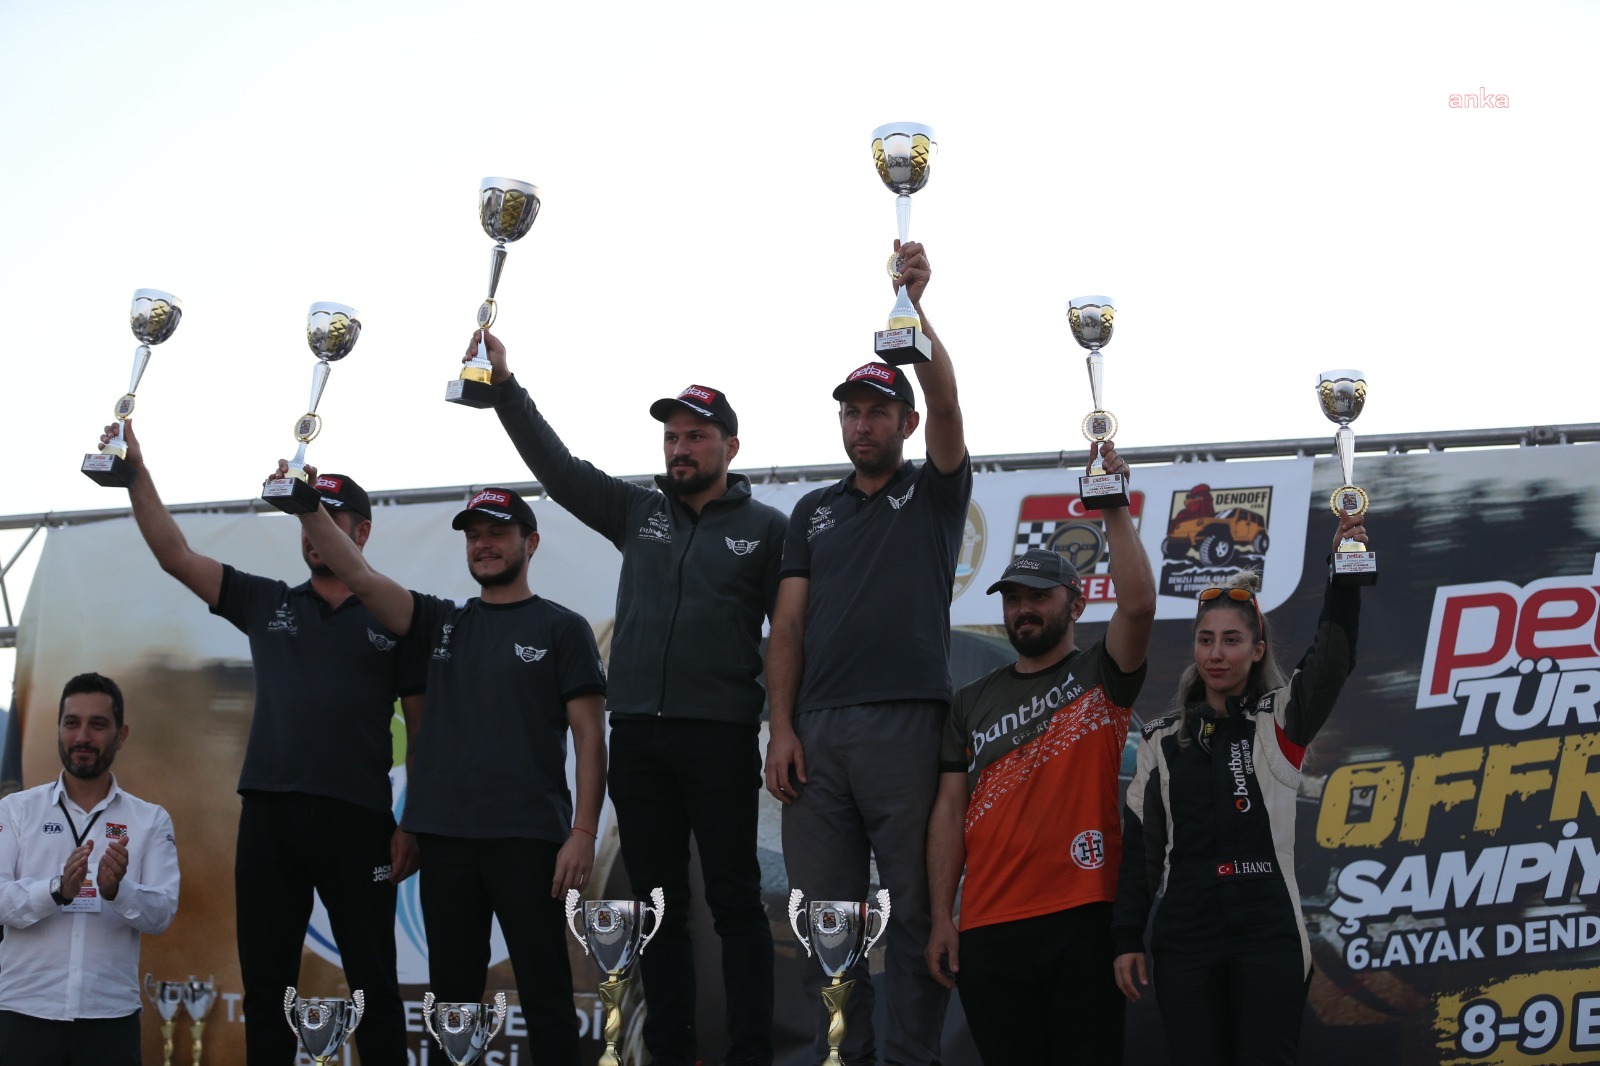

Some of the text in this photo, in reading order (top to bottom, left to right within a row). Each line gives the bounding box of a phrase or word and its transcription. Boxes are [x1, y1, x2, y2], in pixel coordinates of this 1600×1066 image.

[849, 365, 890, 380] petlas
[1215, 491, 1268, 505] DENDOFF
[1430, 586, 1600, 696] pe
[44, 824, 62, 832] FIA
[1242, 861, 1273, 874] HANCI
[1347, 926, 1485, 970] 6.AYAK
[1461, 1000, 1558, 1053] 8-9
